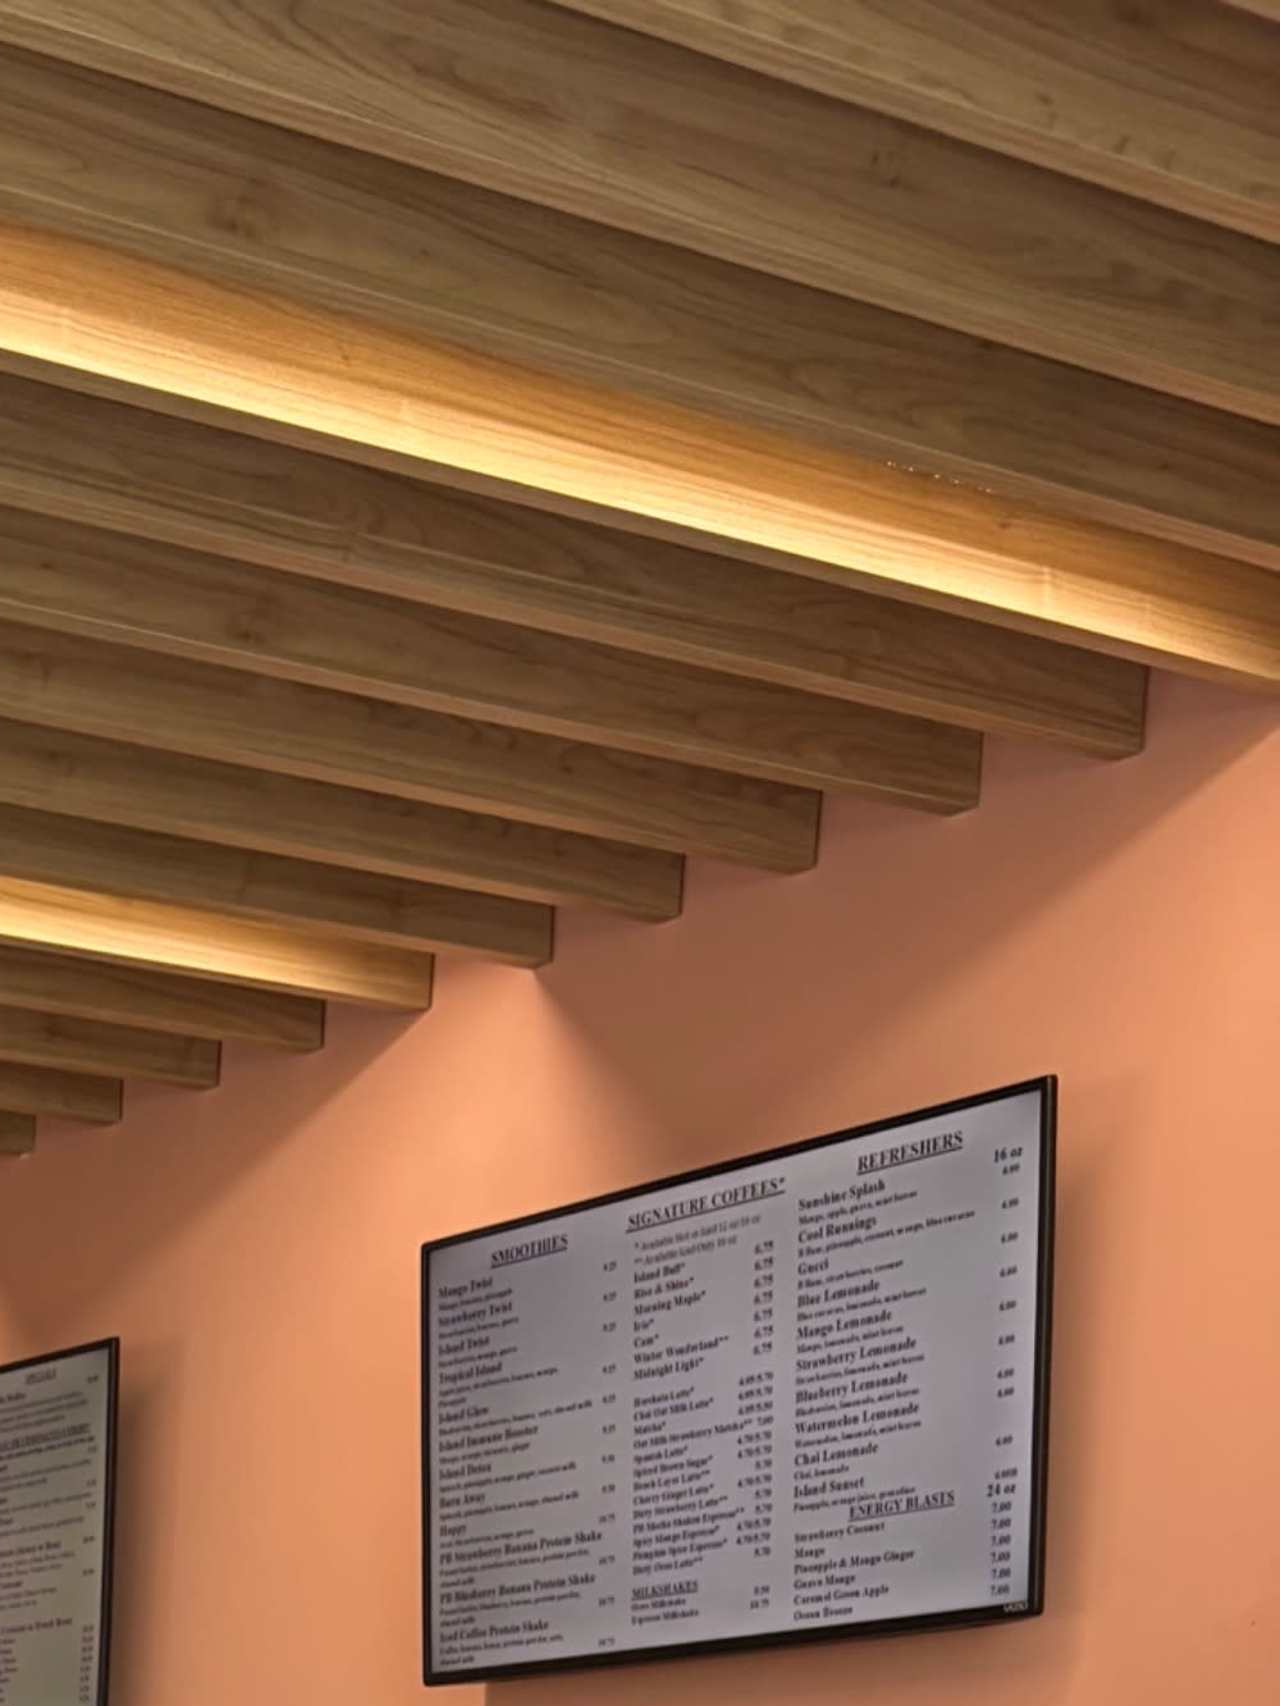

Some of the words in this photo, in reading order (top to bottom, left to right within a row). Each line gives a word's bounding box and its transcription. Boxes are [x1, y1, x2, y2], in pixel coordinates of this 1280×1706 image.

[857, 1129, 963, 1174] REFRESHERS
[994, 1147, 1007, 1163] 16
[1010, 1145, 1022, 1159] oz
[798, 1187, 847, 1212] Sunshine
[848, 1178, 885, 1201] Splash
[627, 1195, 708, 1232] SIGNATURE
[798, 1225, 823, 1244] Cool
[825, 1213, 876, 1240] Runnings
[491, 1232, 567, 1268] SMOOTHIES
[797, 1291, 820, 1308] Blue
[824, 1278, 879, 1302] Lemonade
[796, 1320, 833, 1342] Mango
[836, 1308, 891, 1332] Lemonade
[796, 1348, 855, 1373] Strawberry
[860, 1336, 916, 1359] Lemonade
[795, 1382, 847, 1405] Blueberry
[851, 1370, 907, 1393] Lemonade
[795, 1412, 858, 1435] Watermelon
[863, 1401, 918, 1423] Lemonade
[794, 1450, 820, 1466] Chai
[823, 1441, 877, 1462] Lemonade
[794, 1482, 826, 1498] Island
[829, 1476, 864, 1493] Sunset
[849, 1499, 902, 1521] ENERGY
[905, 1490, 955, 1513] BLASTS
